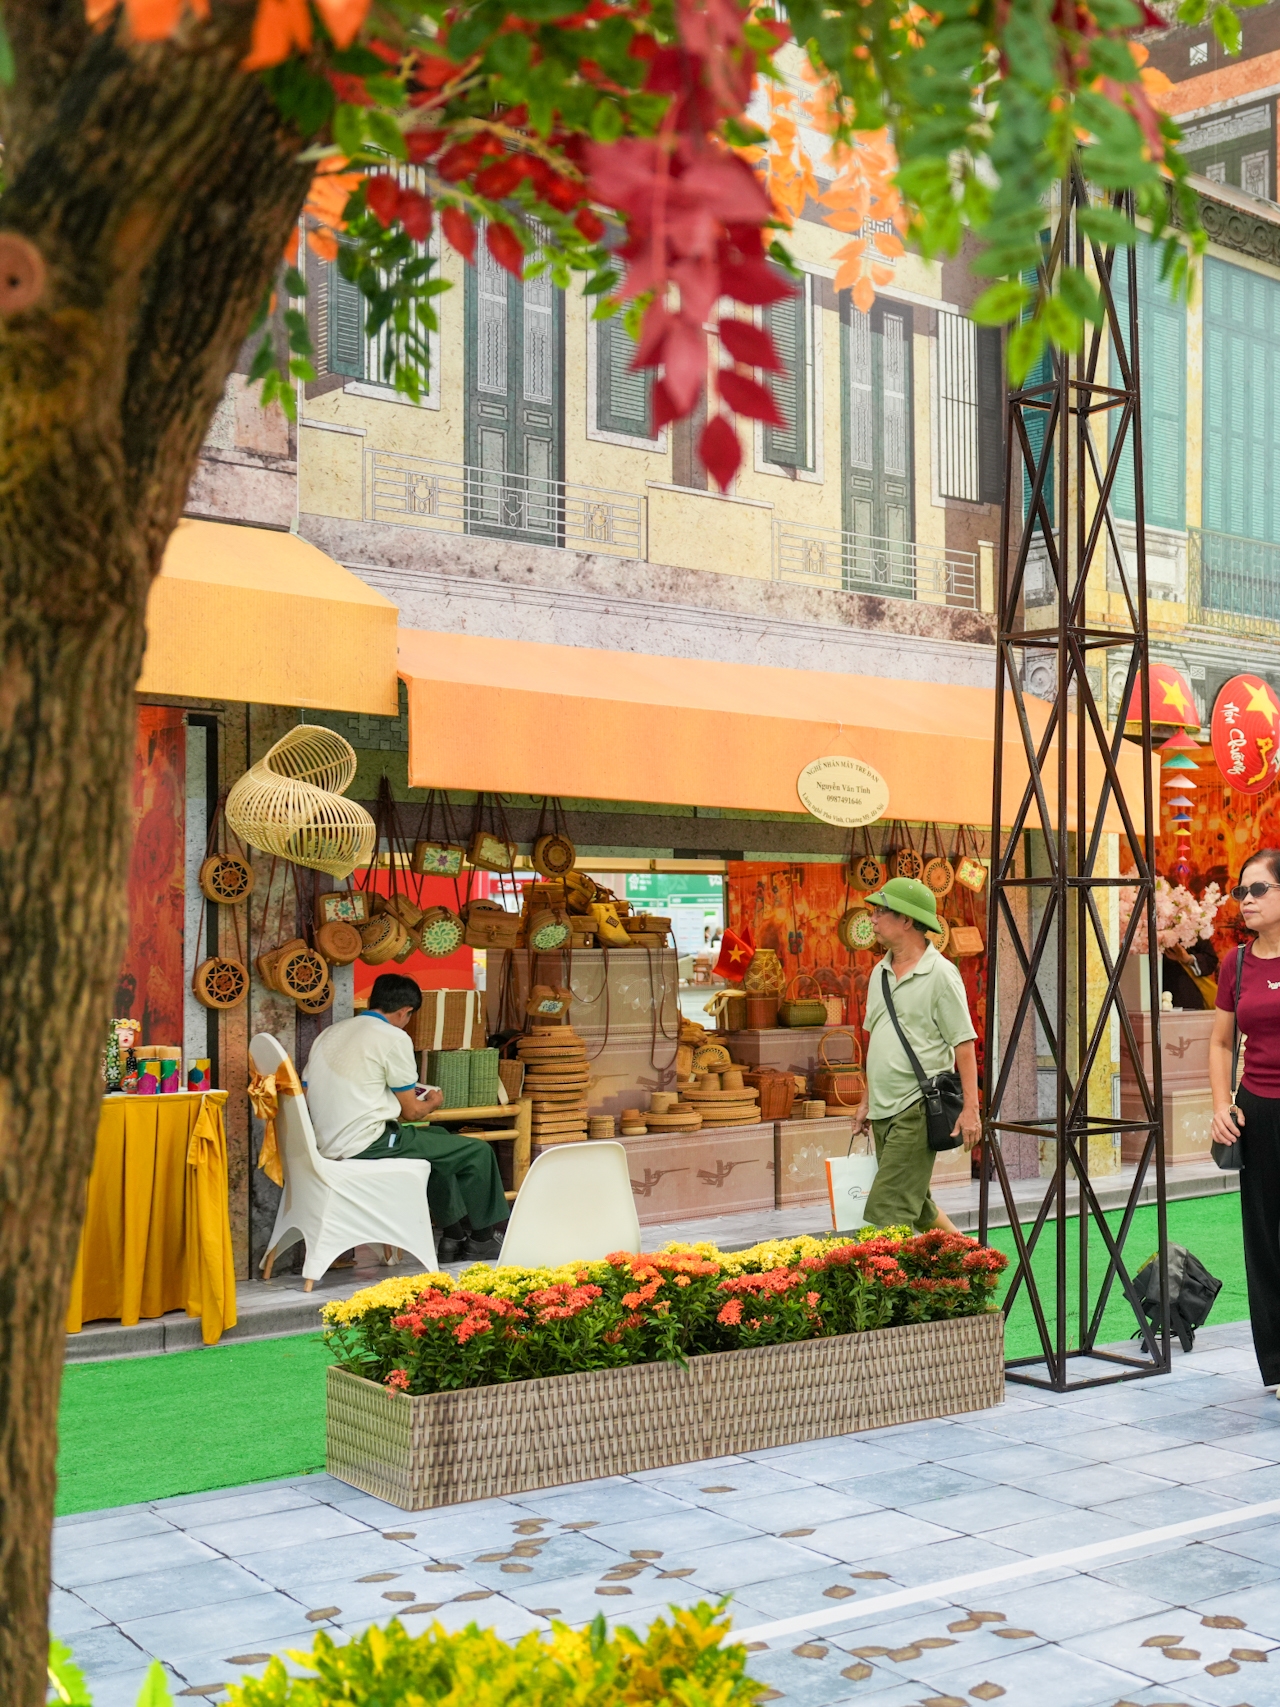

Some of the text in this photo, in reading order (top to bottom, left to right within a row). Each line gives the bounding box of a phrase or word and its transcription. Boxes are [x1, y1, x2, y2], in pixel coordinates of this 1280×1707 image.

[823, 760, 840, 768] NHÂN
[840, 760, 854, 769] MÂY
[855, 764, 866, 775] TRE
[866, 770, 879, 783] ĐAN
[816, 781, 841, 791] Nguyễn
